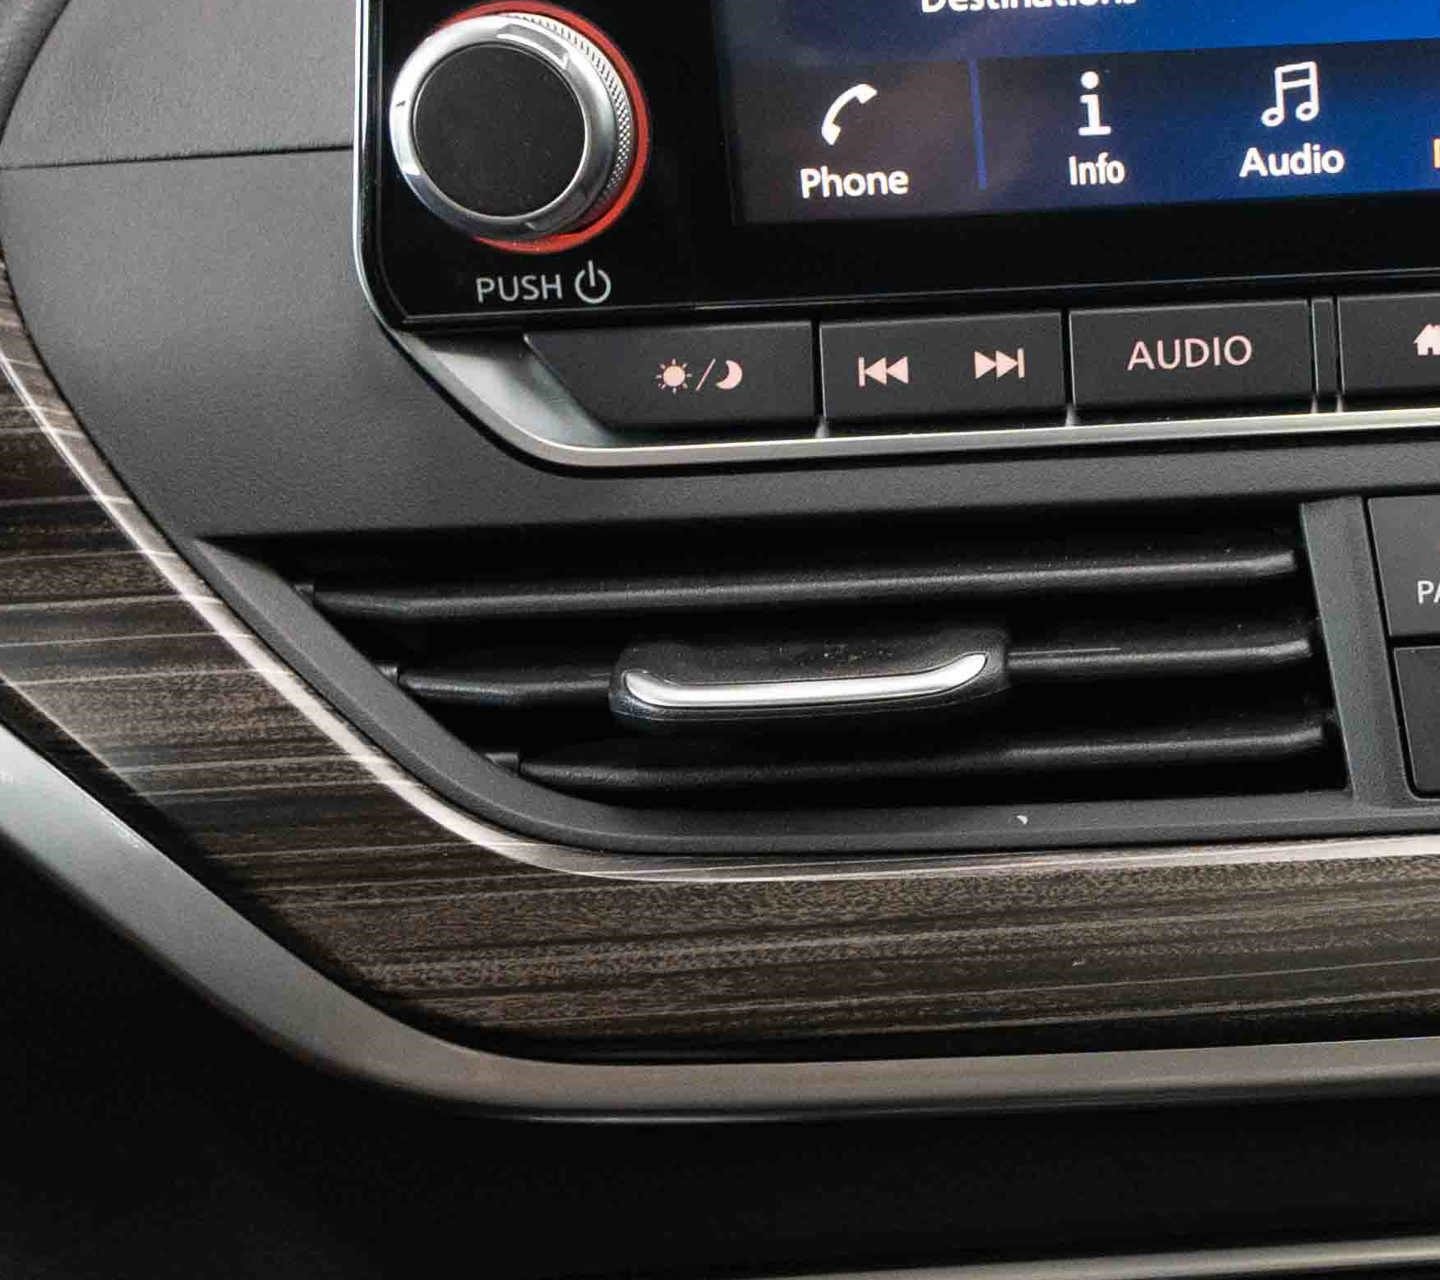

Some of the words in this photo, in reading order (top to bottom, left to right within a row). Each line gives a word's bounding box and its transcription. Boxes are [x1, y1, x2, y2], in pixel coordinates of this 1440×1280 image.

[1068, 151, 1126, 186] Info
[1238, 142, 1346, 178] Audio
[800, 165, 909, 199] Phone
[475, 273, 563, 303] PUSH
[1127, 335, 1252, 371] AUDIO
